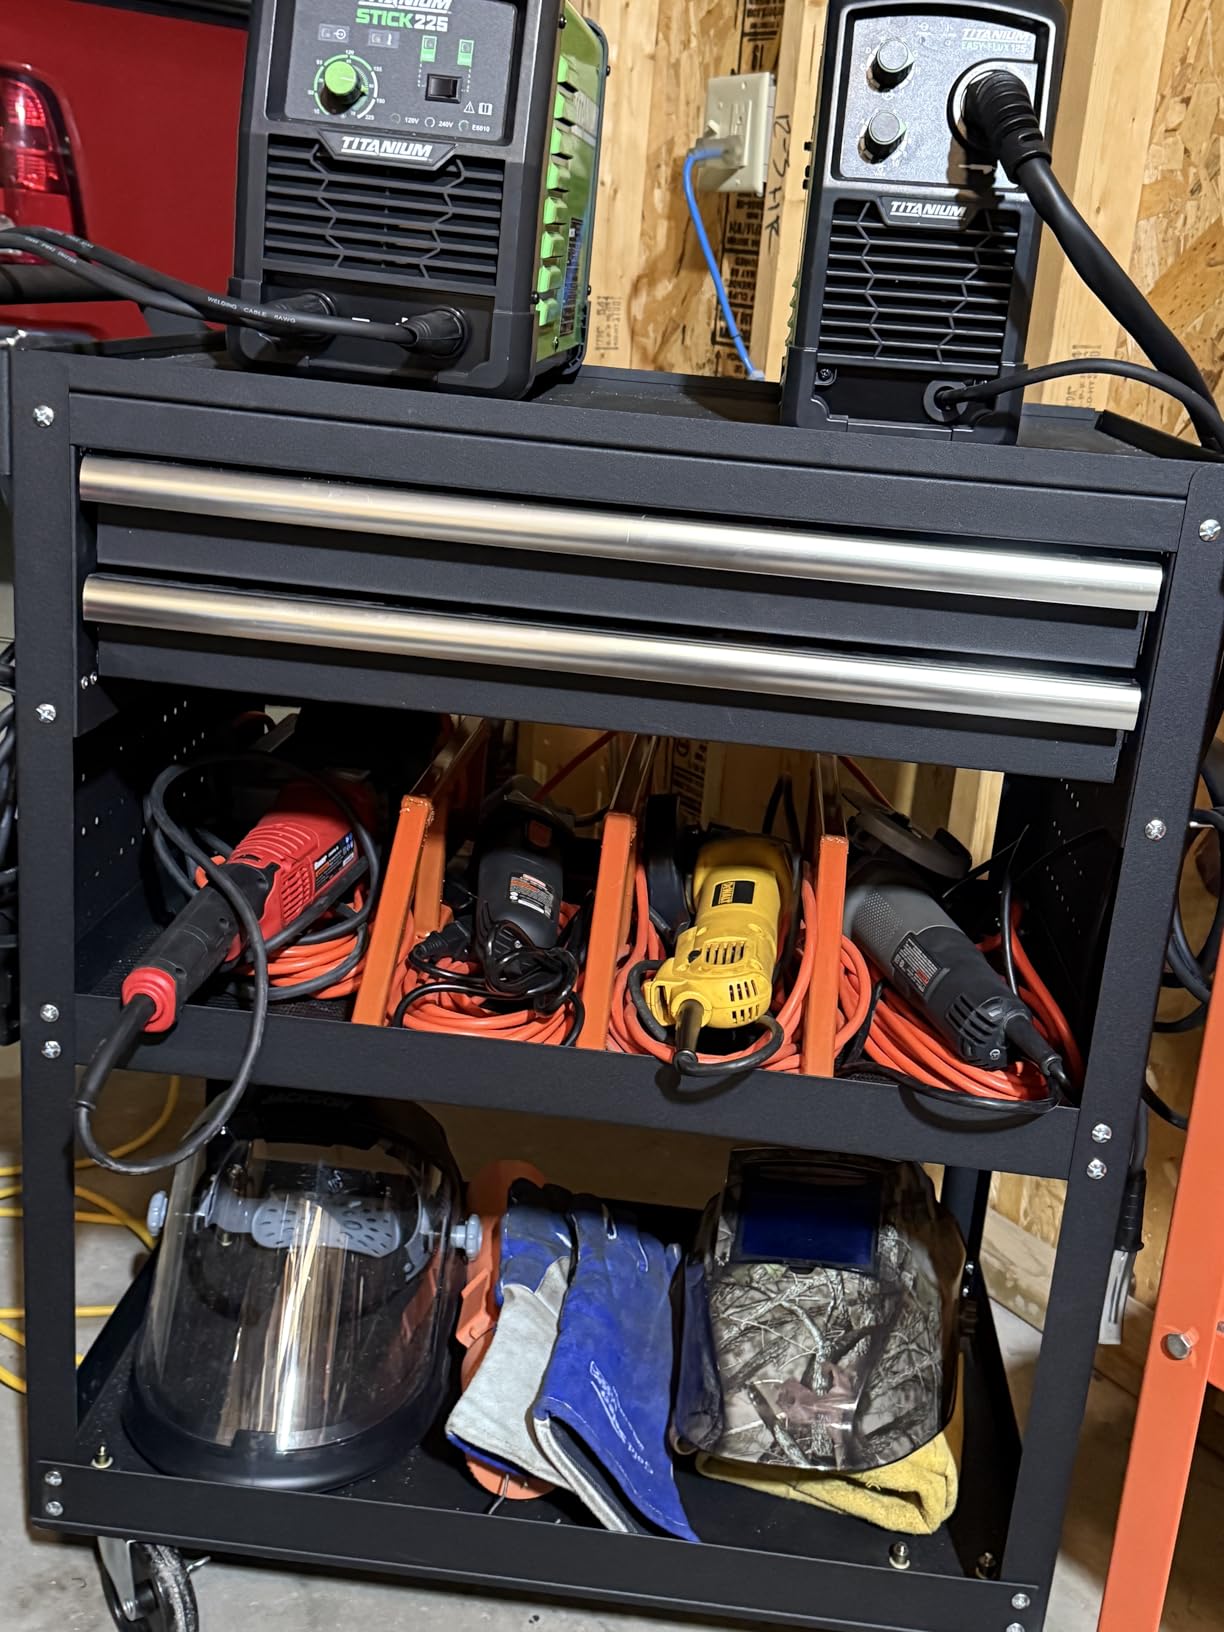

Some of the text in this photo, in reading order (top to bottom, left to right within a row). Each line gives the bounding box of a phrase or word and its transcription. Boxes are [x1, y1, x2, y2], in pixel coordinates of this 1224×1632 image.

[355, 8, 449, 32] STICK 225
[962, 28, 1029, 42] TITANIUM
[1011, 44, 1027, 54] 125
[404, 116, 420, 125] 120V
[438, 120, 454, 128] 240V
[341, 136, 433, 160] TITANIUM
[890, 201, 967, 219] TITANIUM
[207, 296, 237, 310] WELDING
[243, 307, 267, 317] CABLE
